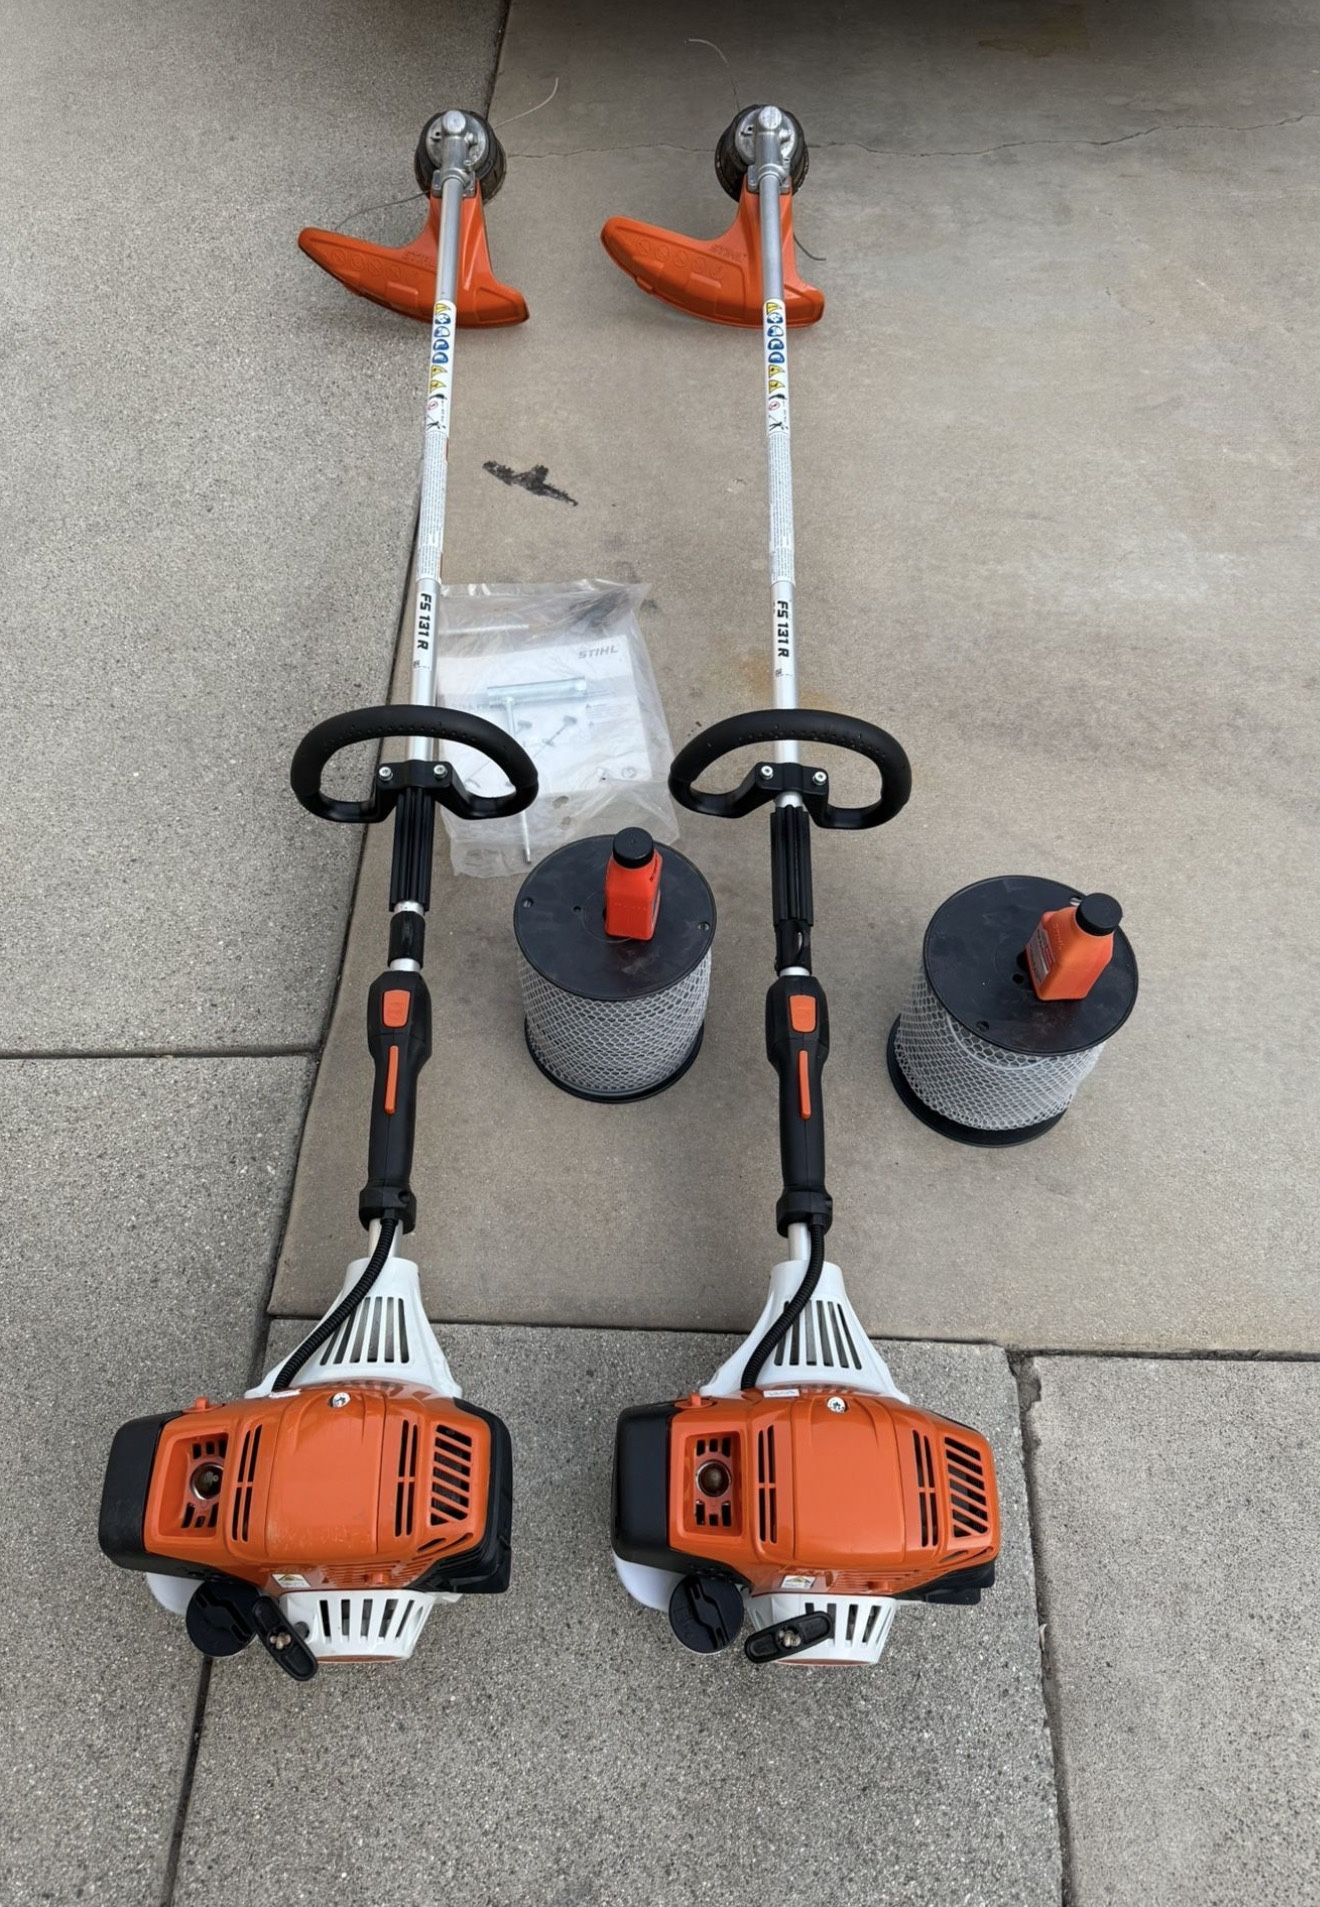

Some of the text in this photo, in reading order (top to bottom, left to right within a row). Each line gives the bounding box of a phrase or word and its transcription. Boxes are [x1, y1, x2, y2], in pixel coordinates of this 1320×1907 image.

[420, 593, 432, 611] FS
[777, 600, 789, 619] FS
[418, 615, 431, 637] 131
[777, 622, 789, 644] 131
[417, 639, 429, 650] R
[578, 645, 619, 659] STIHL
[778, 647, 790, 658] R
